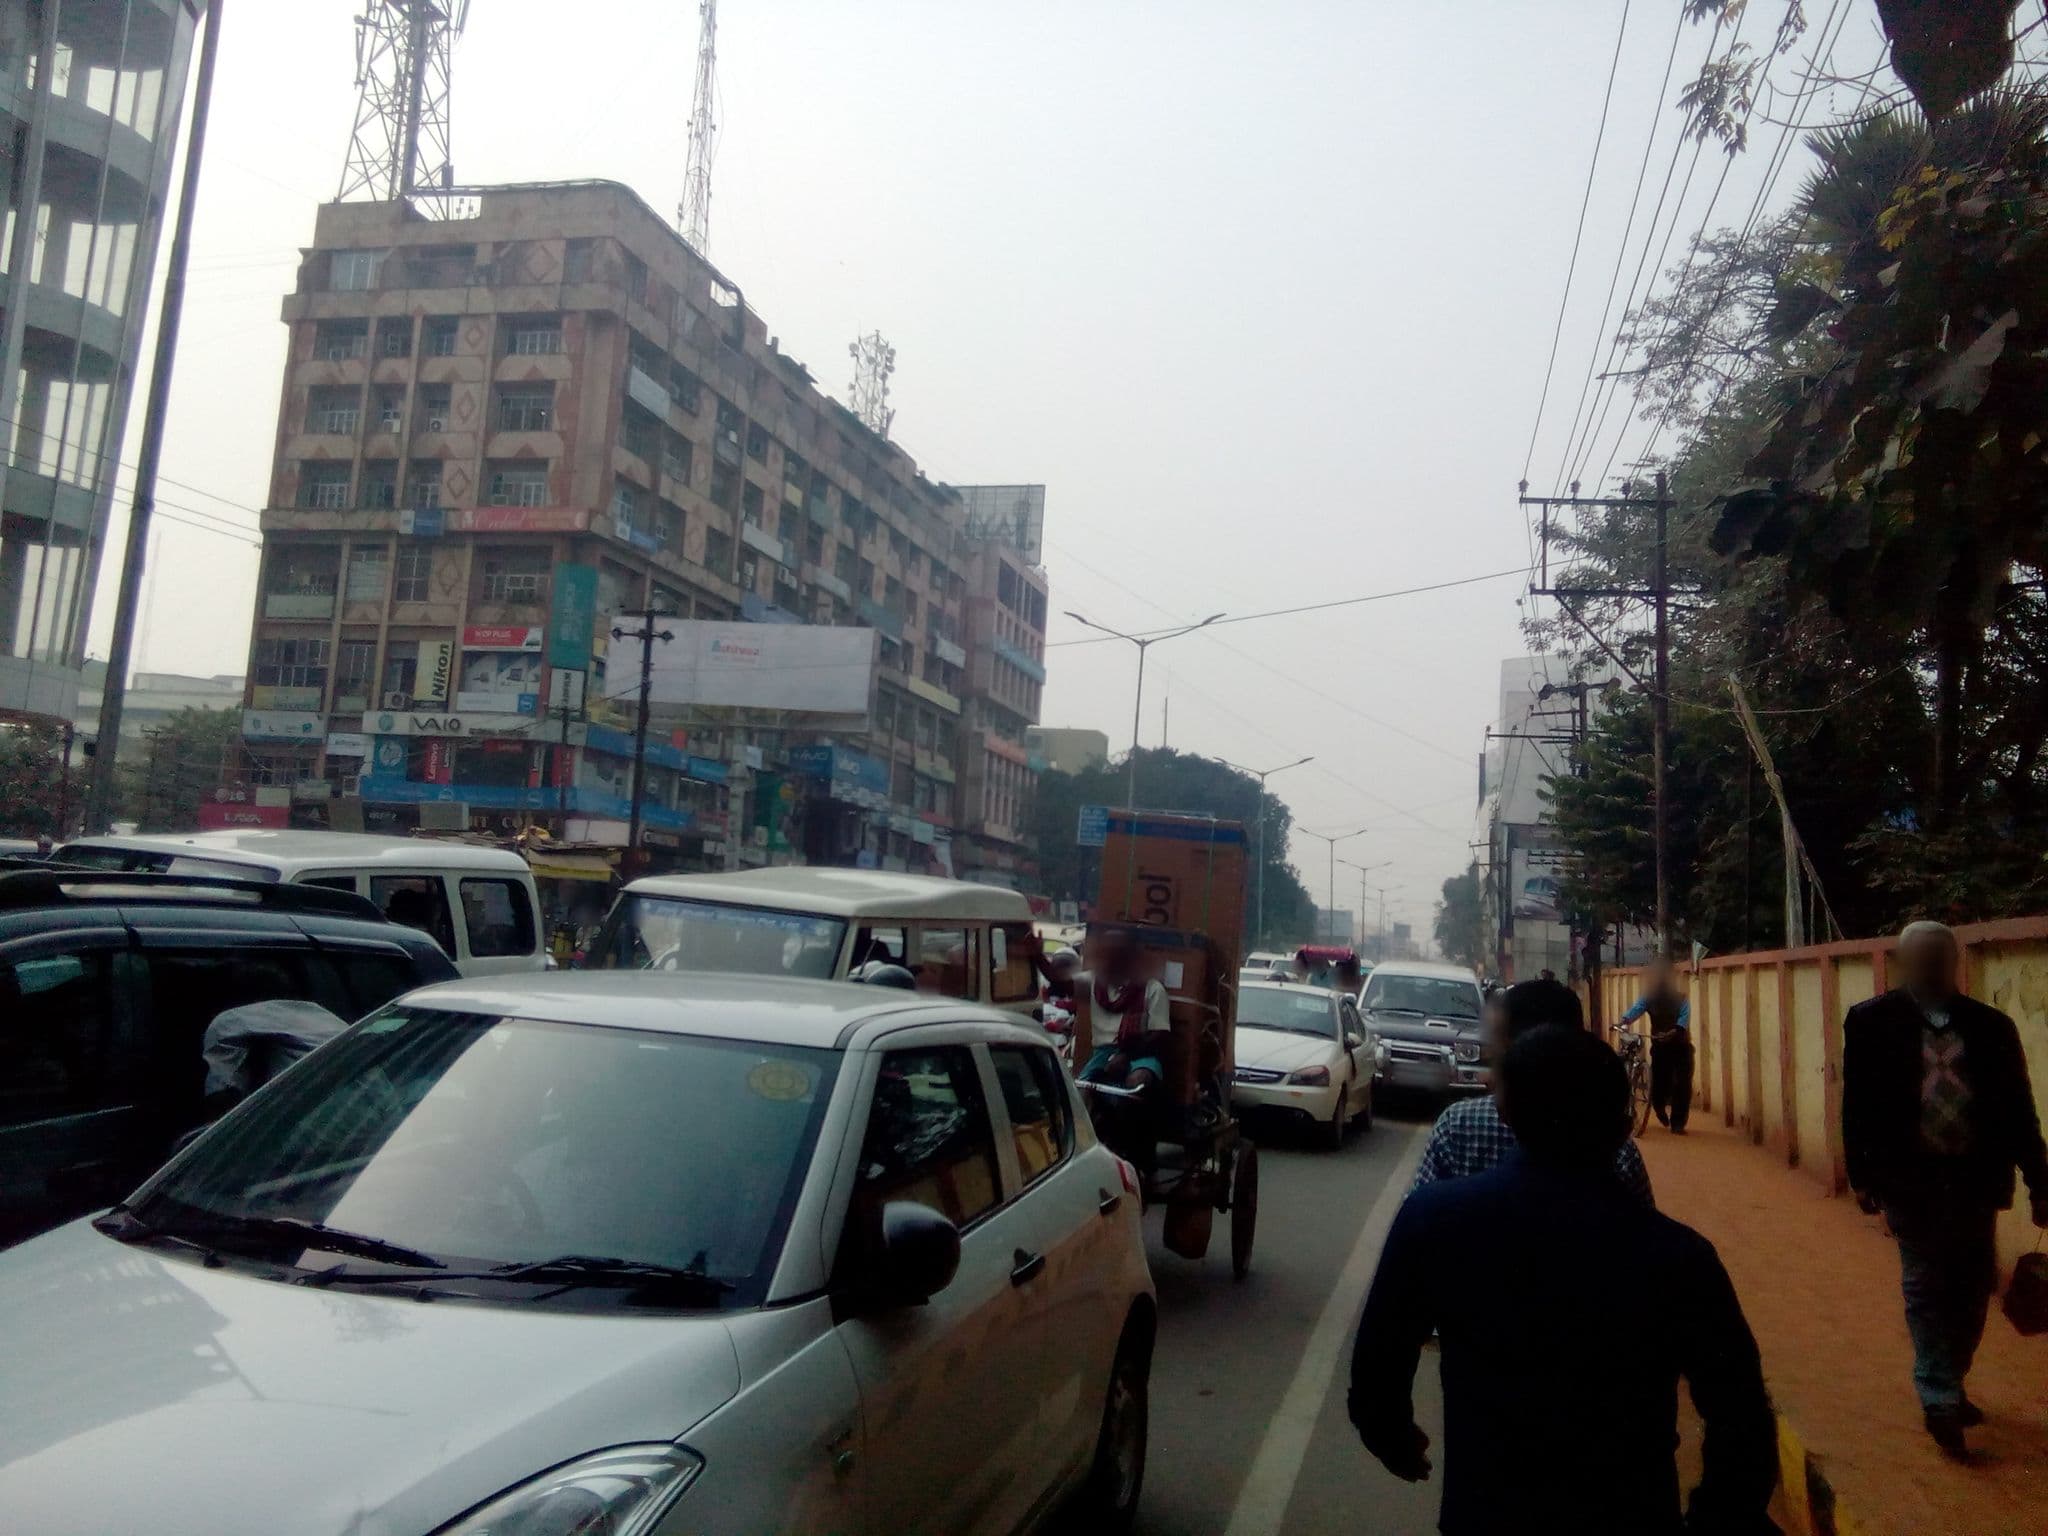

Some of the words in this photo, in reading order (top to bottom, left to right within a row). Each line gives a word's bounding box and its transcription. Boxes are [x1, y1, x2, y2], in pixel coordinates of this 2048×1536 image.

[431, 642, 450, 698] Nikon
[412, 717, 461, 731] VAIO
[429, 743, 439, 780] Lenovo
